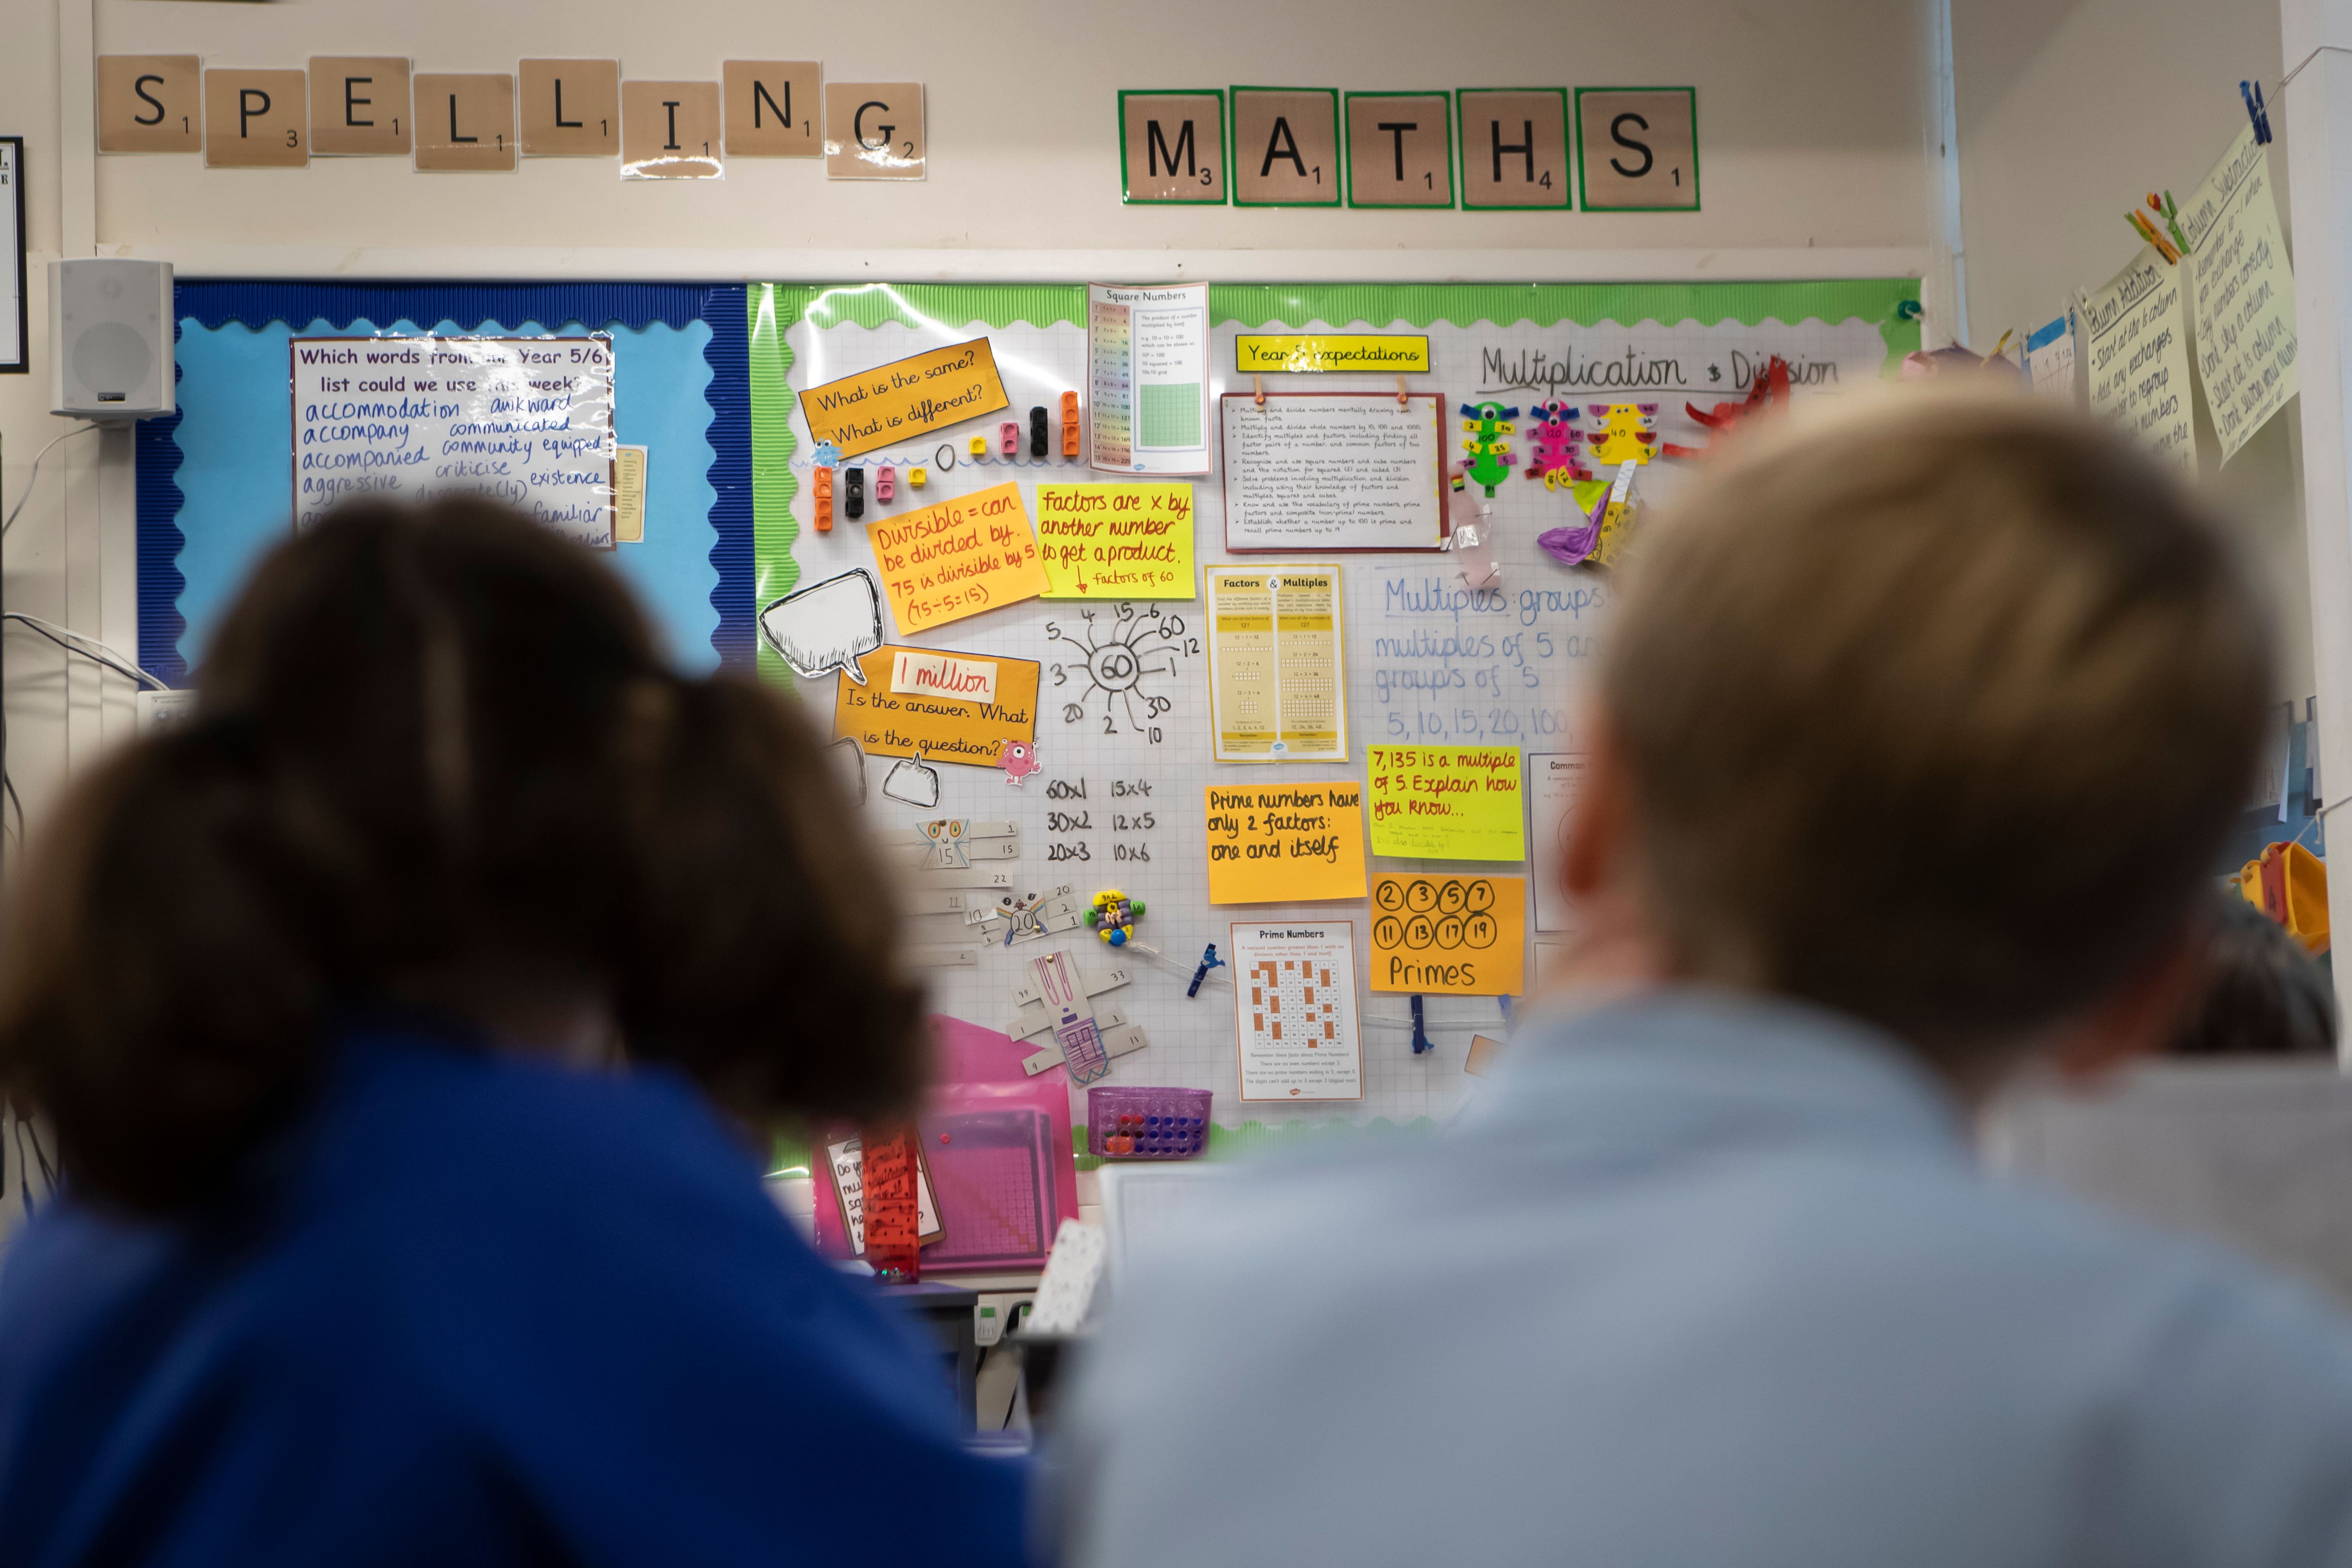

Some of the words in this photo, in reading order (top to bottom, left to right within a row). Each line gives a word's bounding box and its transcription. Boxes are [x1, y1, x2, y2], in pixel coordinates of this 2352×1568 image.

[1107, 290, 1139, 303] Square
[1143, 291, 1186, 301] Numbers
[300, 349, 358, 365] Which
[367, 348, 420, 364] words
[519, 349, 562, 364] Year
[571, 349, 603, 364] 5/6
[1248, 344, 1289, 361] Year
[1313, 346, 1419, 367] expectations
[817, 385, 868, 412] What
[872, 383, 888, 395] is
[891, 369, 920, 390] the
[925, 350, 975, 380] same?
[1483, 344, 1688, 398] Multiplication
[321, 376, 350, 392] list
[358, 376, 405, 392] could
[414, 380, 437, 392] we
[446, 380, 477, 392] use
[306, 397, 460, 422] accommodation
[490, 394, 575, 413] awkward
[831, 418, 882, 443] What
[886, 416, 903, 428] is
[907, 383, 983, 423] different?
[303, 424, 409, 449] accompany
[450, 415, 573, 437] communicated
[1241, 424, 1267, 433] Multiply
[1358, 424, 1366, 433] by
[303, 445, 430, 473] accompanied
[435, 460, 511, 478] criticise
[442, 435, 532, 465] community
[543, 435, 601, 459] equipped
[303, 472, 402, 507] aggressive
[530, 469, 605, 487] existence
[533, 501, 603, 523] familiar
[1043, 490, 1106, 512] Factors
[1113, 496, 1141, 511] are
[1167, 493, 1191, 520] by
[877, 508, 965, 549] Divisible
[981, 495, 1017, 516] can
[1041, 517, 1103, 538] another
[1109, 518, 1175, 536] number
[883, 553, 906, 572] be
[911, 529, 983, 564] divided
[1042, 543, 1057, 561] to
[1060, 542, 1086, 569] get
[1093, 547, 1105, 562] a
[1107, 539, 1181, 570] product.
[891, 580, 915, 599] 75
[921, 575, 935, 589] is
[937, 557, 1002, 585] divisible
[1004, 549, 1023, 568] by
[1025, 544, 1035, 560] 5
[1142, 570, 1156, 583] of
[1159, 570, 1174, 583] 60
[1223, 579, 1260, 588] Factors
[1269, 579, 1278, 589] &
[1283, 578, 1328, 588] Multiples
[1081, 608, 1095, 623] 4
[1113, 602, 1134, 622] 15
[1150, 602, 1160, 618] 6
[1519, 588, 1606, 627] groups
[1045, 621, 1061, 640] 5
[1158, 614, 1185, 639] 60
[1183, 637, 1200, 658] 12
[1375, 625, 1495, 668] multiples
[1502, 632, 1524, 667] of
[1536, 631, 1553, 658] 5
[901, 656, 907, 685] 1
[916, 658, 990, 694] million
[1050, 663, 1067, 686] 3
[1101, 654, 1133, 680] 60
[1375, 667, 1466, 704] groups
[1475, 664, 1501, 698] of
[1522, 665, 1539, 688] 5
[846, 689, 866, 707] Is
[871, 692, 900, 710] the
[906, 702, 970, 718] answer.
[979, 702, 1029, 724] What
[1062, 703, 1084, 724] 20
[1145, 696, 1172, 719] 30
[1102, 715, 1117, 734] 2
[1148, 727, 1163, 745] 10
[863, 730, 879, 743] is
[884, 729, 913, 747] the
[919, 738, 1000, 757] question?
[1373, 751, 1416, 771] 7,135
[1423, 752, 1434, 767] is
[1439, 755, 1450, 767] a
[1457, 751, 1515, 774] multiple
[1374, 775, 1388, 795] of
[1413, 774, 1478, 799] Explain
[1486, 775, 1517, 792] how
[1210, 791, 1254, 811] Prime
[1258, 789, 1323, 809] numbers
[1328, 791, 1360, 809] have
[1374, 799, 1402, 821] you
[1208, 816, 1239, 839] only
[1248, 816, 1258, 831] 2
[1211, 843, 1241, 861] one
[1246, 839, 1281, 859] and
[1290, 835, 1339, 863] itself
[1383, 885, 1395, 903] 2
[1419, 886, 1429, 902] 3
[1447, 887, 1460, 904] 5
[1476, 887, 1485, 901] 7
[1260, 930, 1285, 939] Prime
[1287, 930, 1325, 938] Numbers
[1383, 925, 1393, 943] 11
[1415, 925, 1429, 940] 13
[1446, 925, 1459, 939] 17
[1474, 922, 1487, 939] 19
[1390, 956, 1476, 986] Primes
